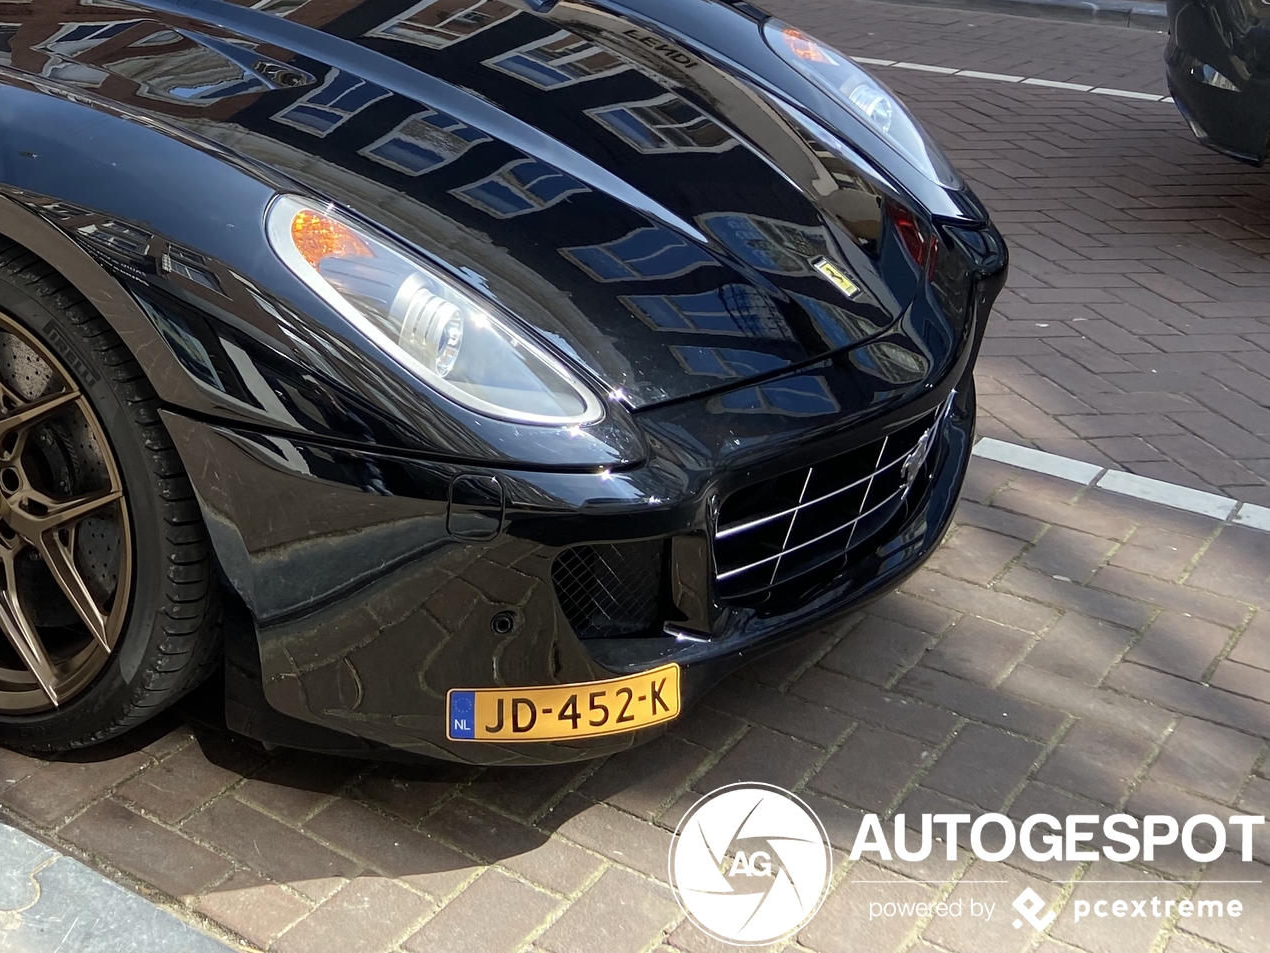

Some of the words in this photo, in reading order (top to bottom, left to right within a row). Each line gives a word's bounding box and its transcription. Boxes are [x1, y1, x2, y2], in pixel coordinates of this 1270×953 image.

[42, 318, 102, 389] PIRELLI
[454, 719, 471, 731] NL
[485, 677, 670, 734] JD-452-K
